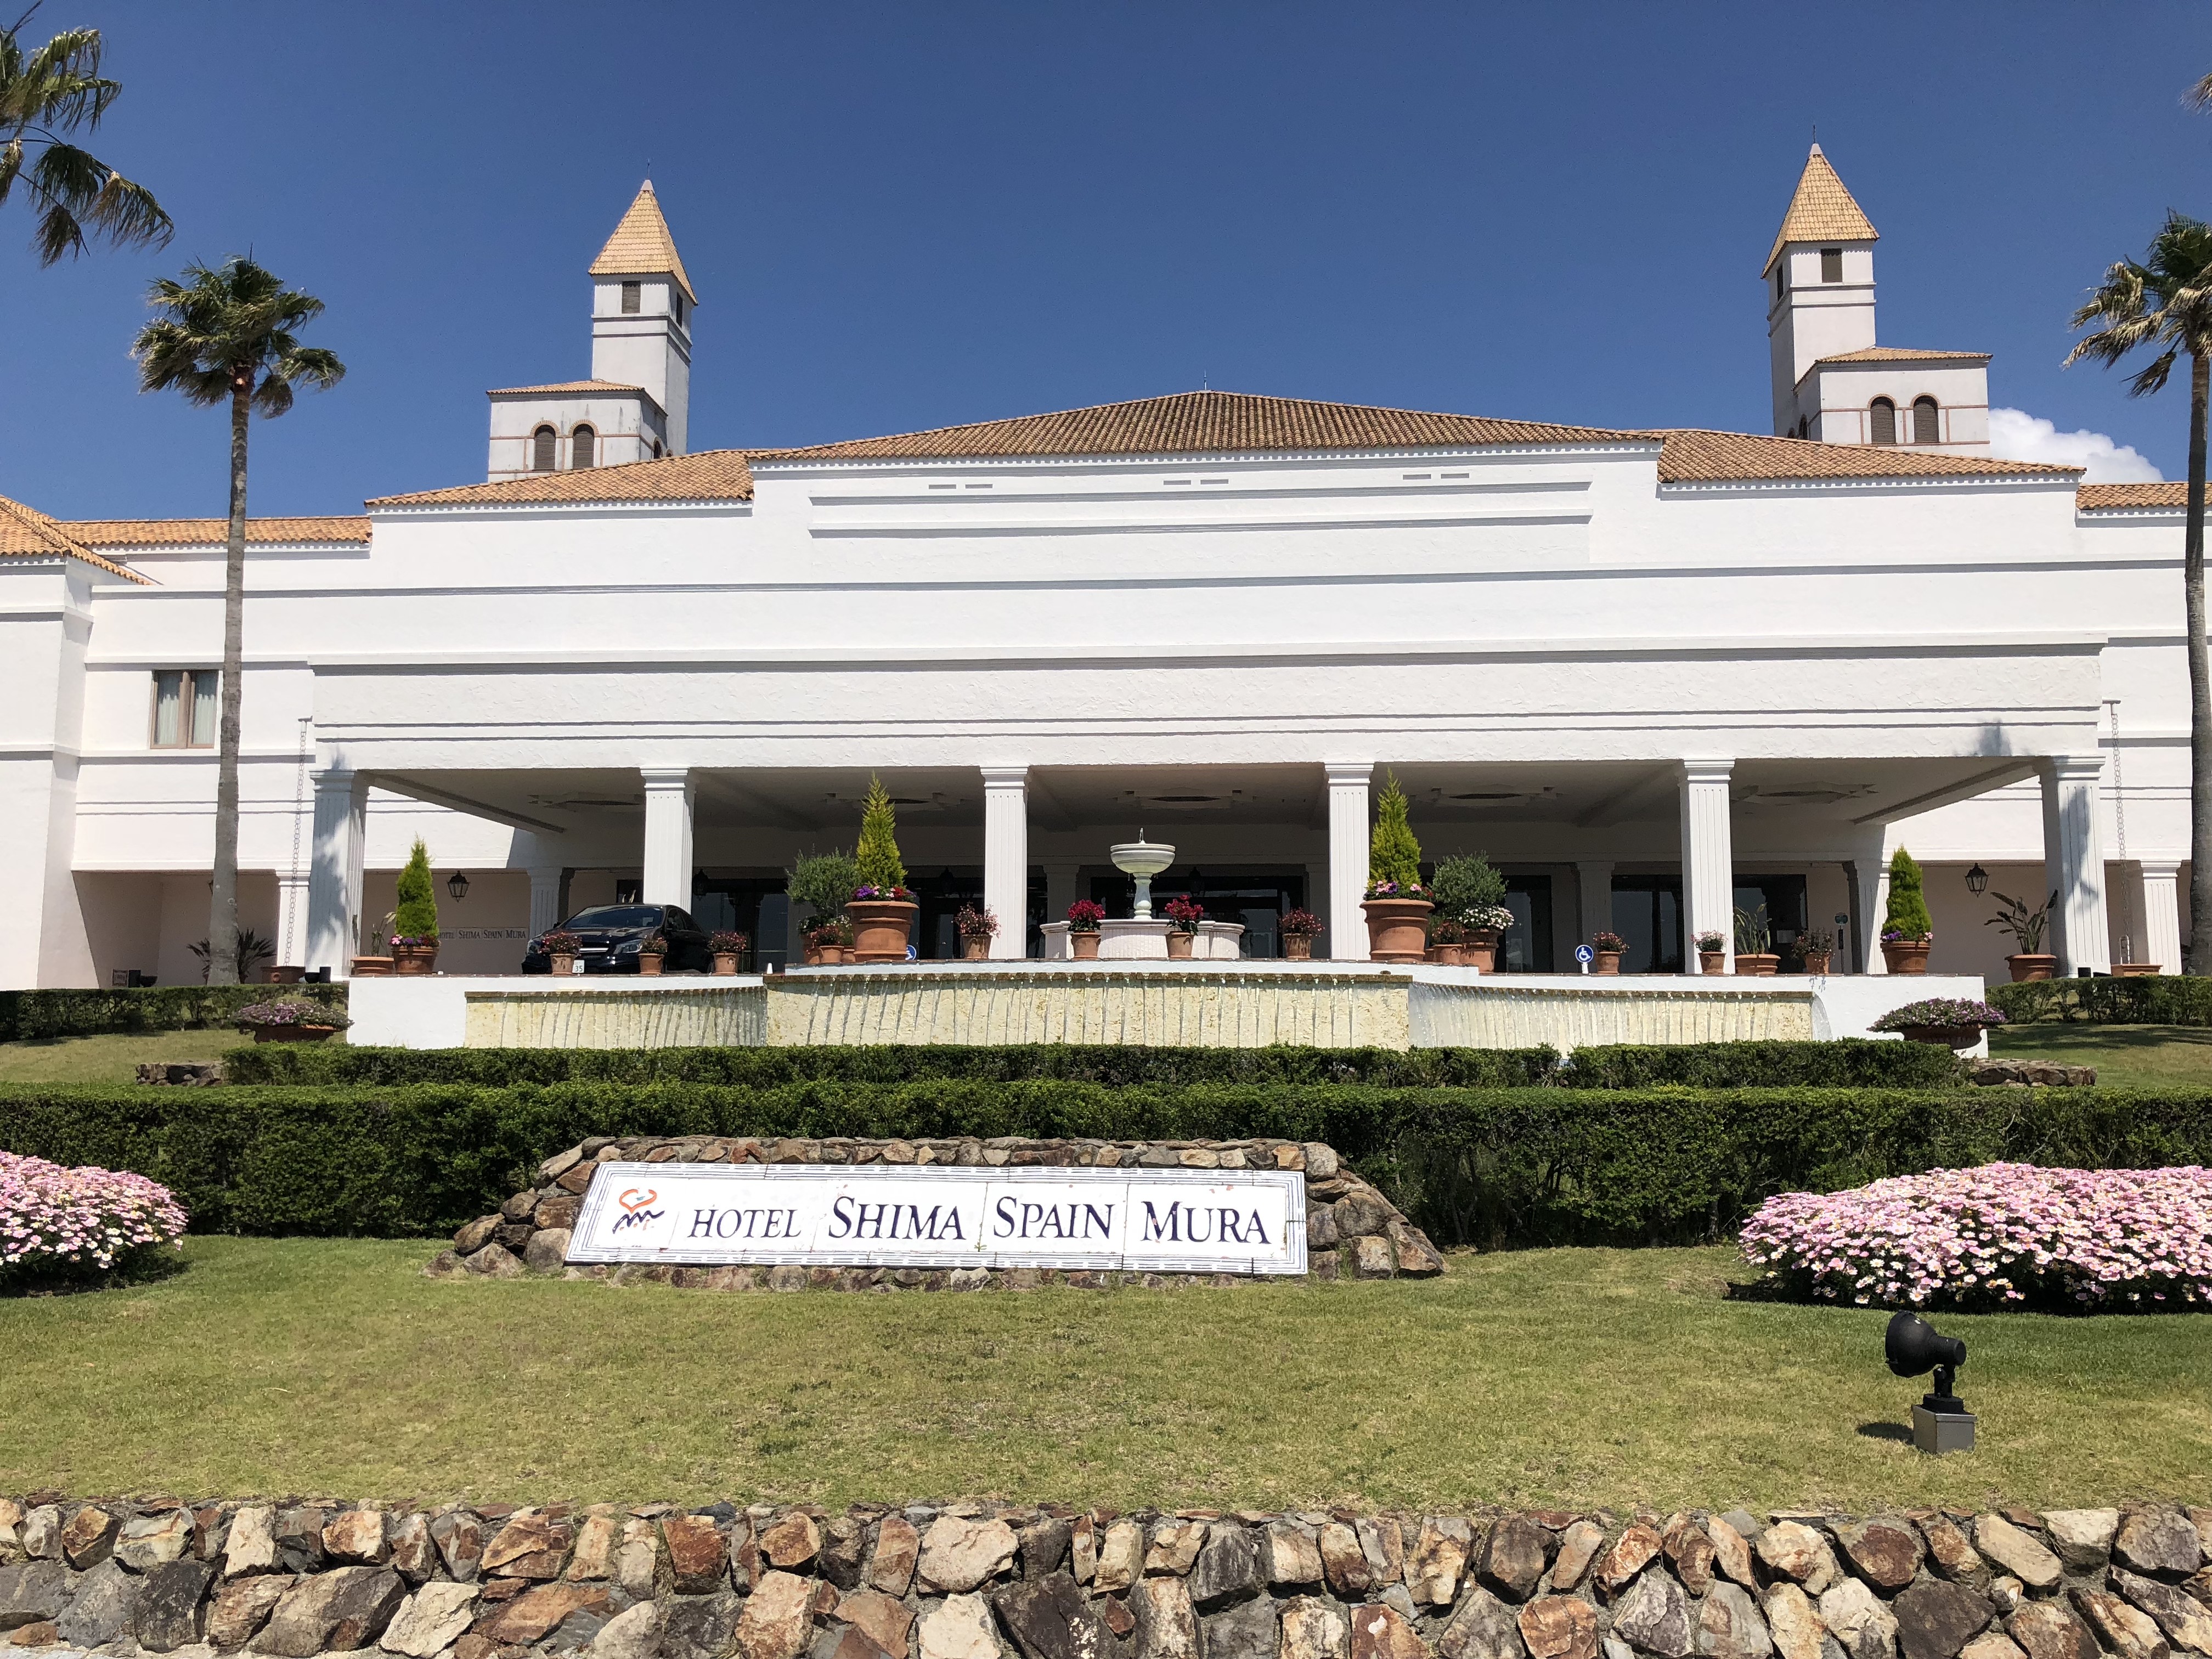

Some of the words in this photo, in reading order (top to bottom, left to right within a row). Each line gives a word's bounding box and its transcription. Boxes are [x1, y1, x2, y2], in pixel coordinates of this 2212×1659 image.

[459, 929, 481, 939] SHIMA
[483, 929, 503, 939] SPAIN
[506, 929, 526, 939] MURA
[687, 1209, 802, 1238] HOTEL
[828, 1196, 967, 1240] SHIMA
[994, 1196, 1115, 1239] SPAIN
[1140, 1201, 1272, 1244] MURA
